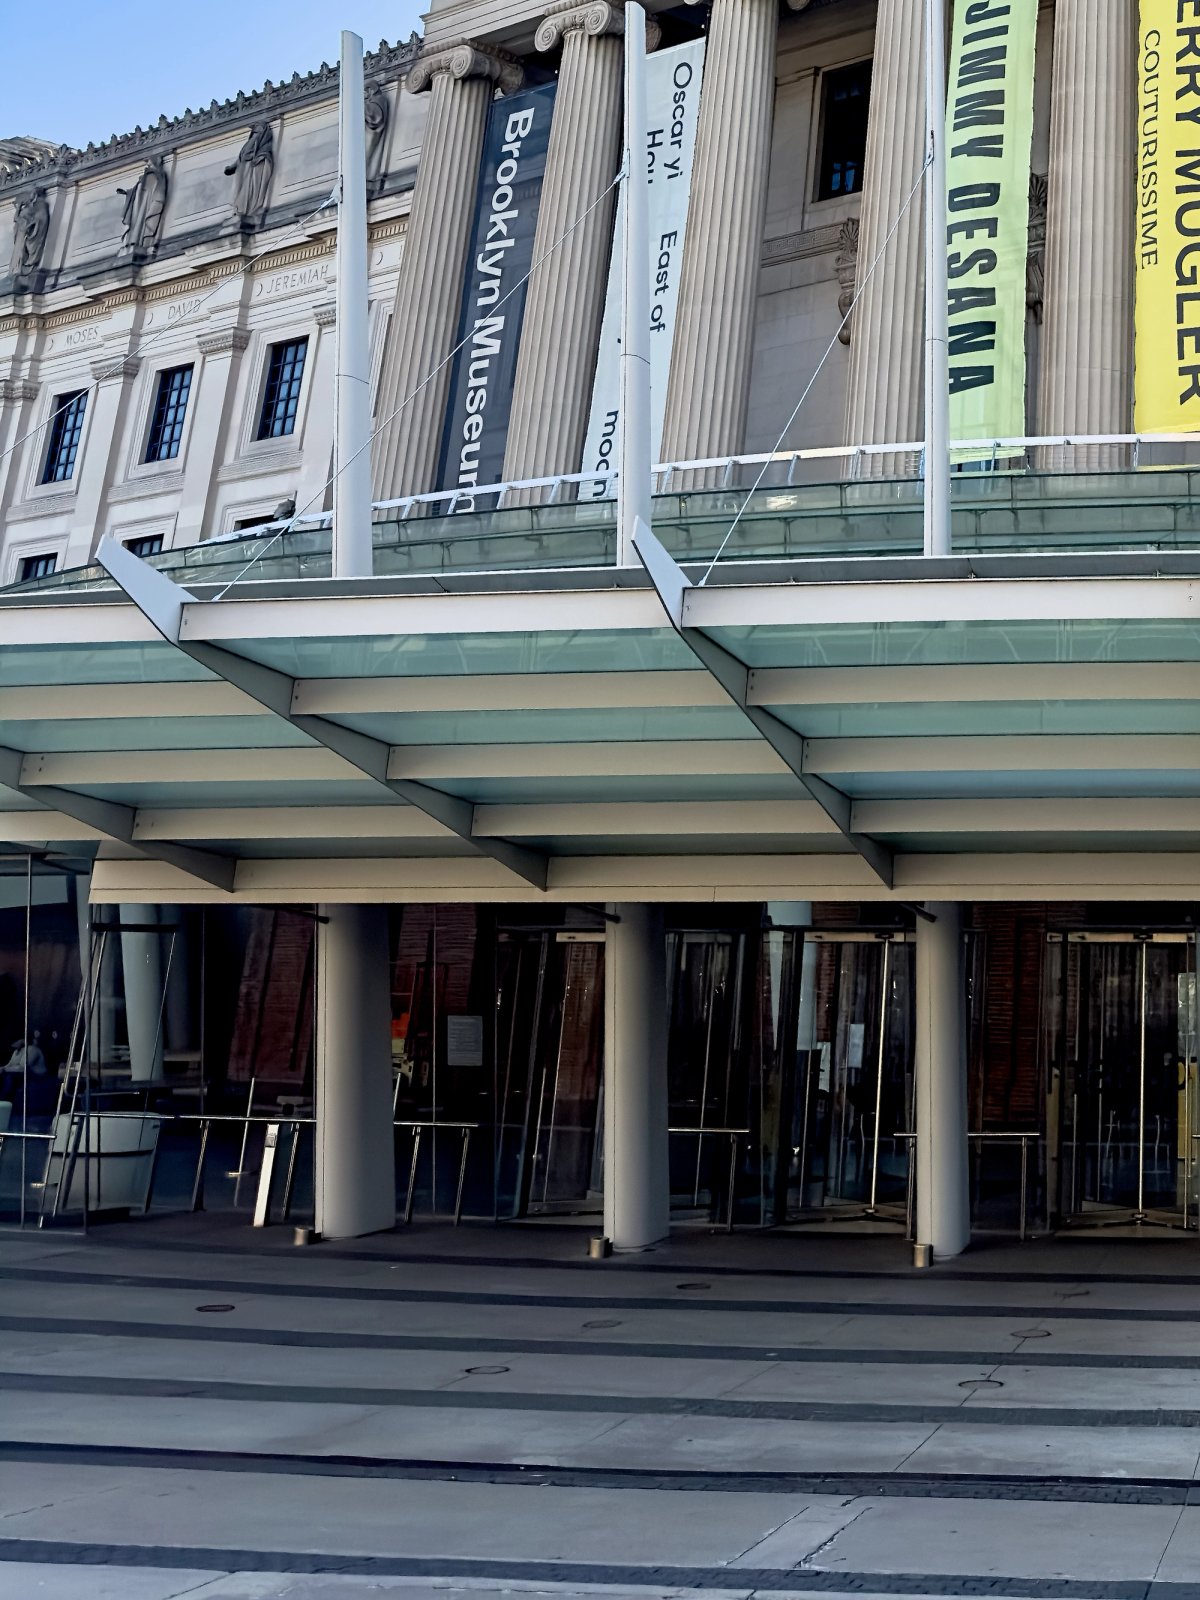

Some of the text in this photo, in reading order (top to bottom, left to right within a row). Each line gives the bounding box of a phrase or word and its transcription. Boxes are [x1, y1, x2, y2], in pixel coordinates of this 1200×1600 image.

[663, 61, 693, 180] Oscar yi
[1141, 29, 1161, 271] COUTURISSIME
[946, 0, 1011, 396] JIMMY DESANA
[167, 298, 202, 321] DAVID
[266, 264, 330, 294] JEREMIAH
[455, 106, 536, 514] Brooklyn Museum
[649, 229, 678, 334] East of
[64, 325, 101, 347] MOSES
